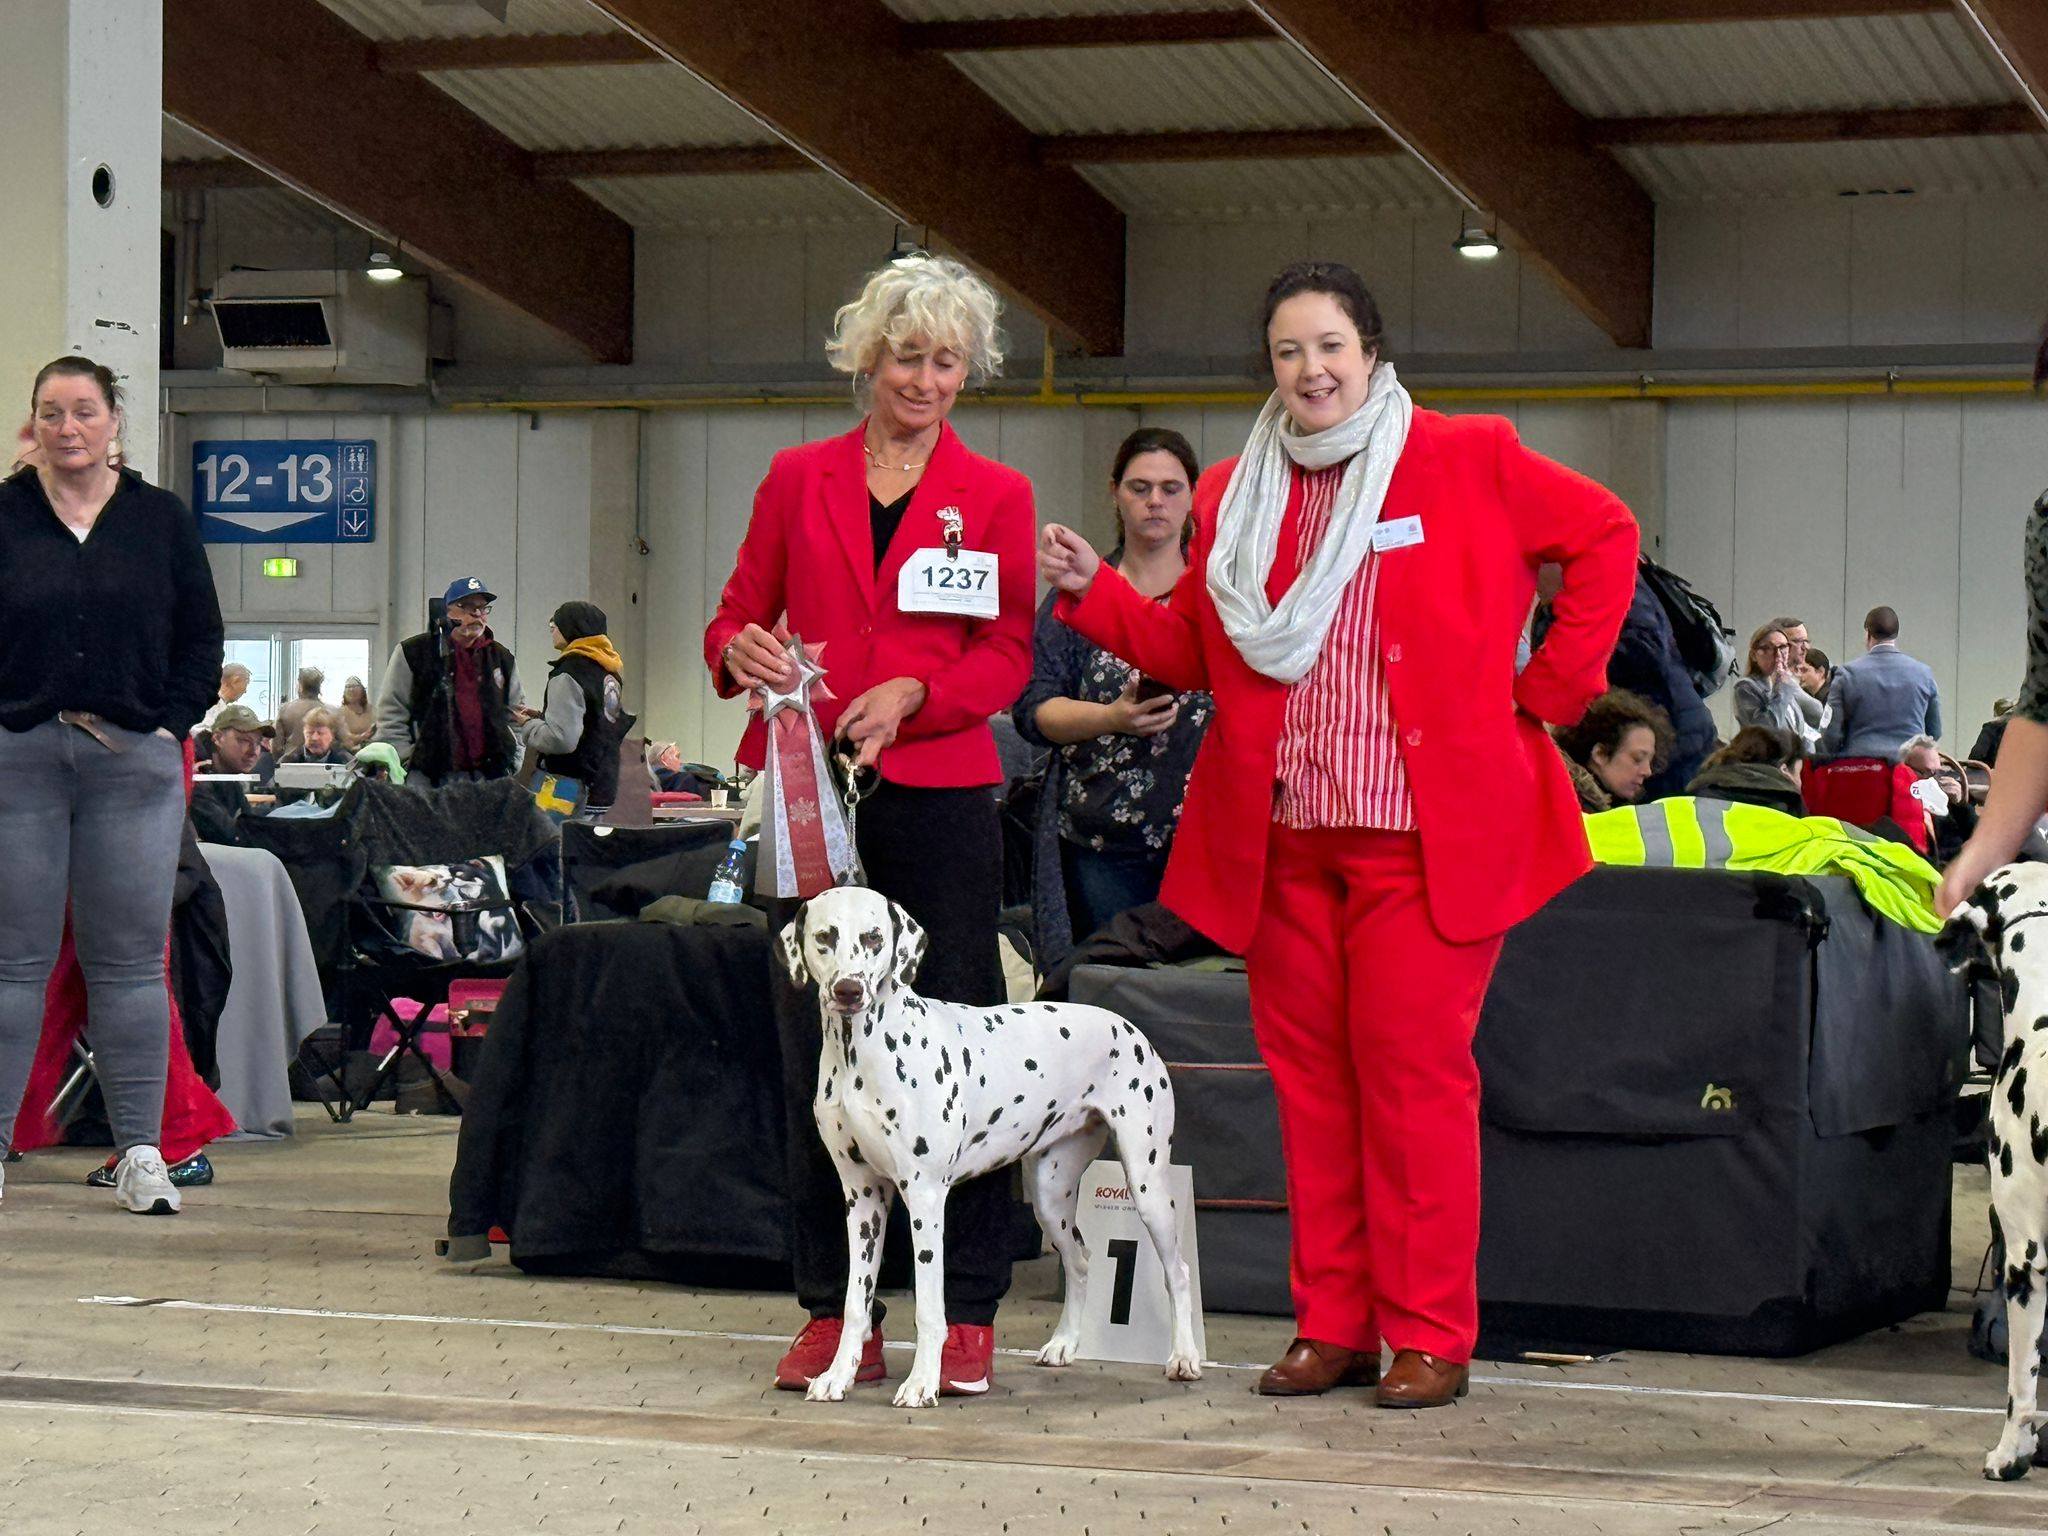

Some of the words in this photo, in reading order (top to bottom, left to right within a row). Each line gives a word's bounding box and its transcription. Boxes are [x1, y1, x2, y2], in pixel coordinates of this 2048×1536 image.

[921, 566, 989, 591] 1237
[1095, 1187, 1130, 1200] ROYAL
[1107, 1239, 1138, 1326] 1
